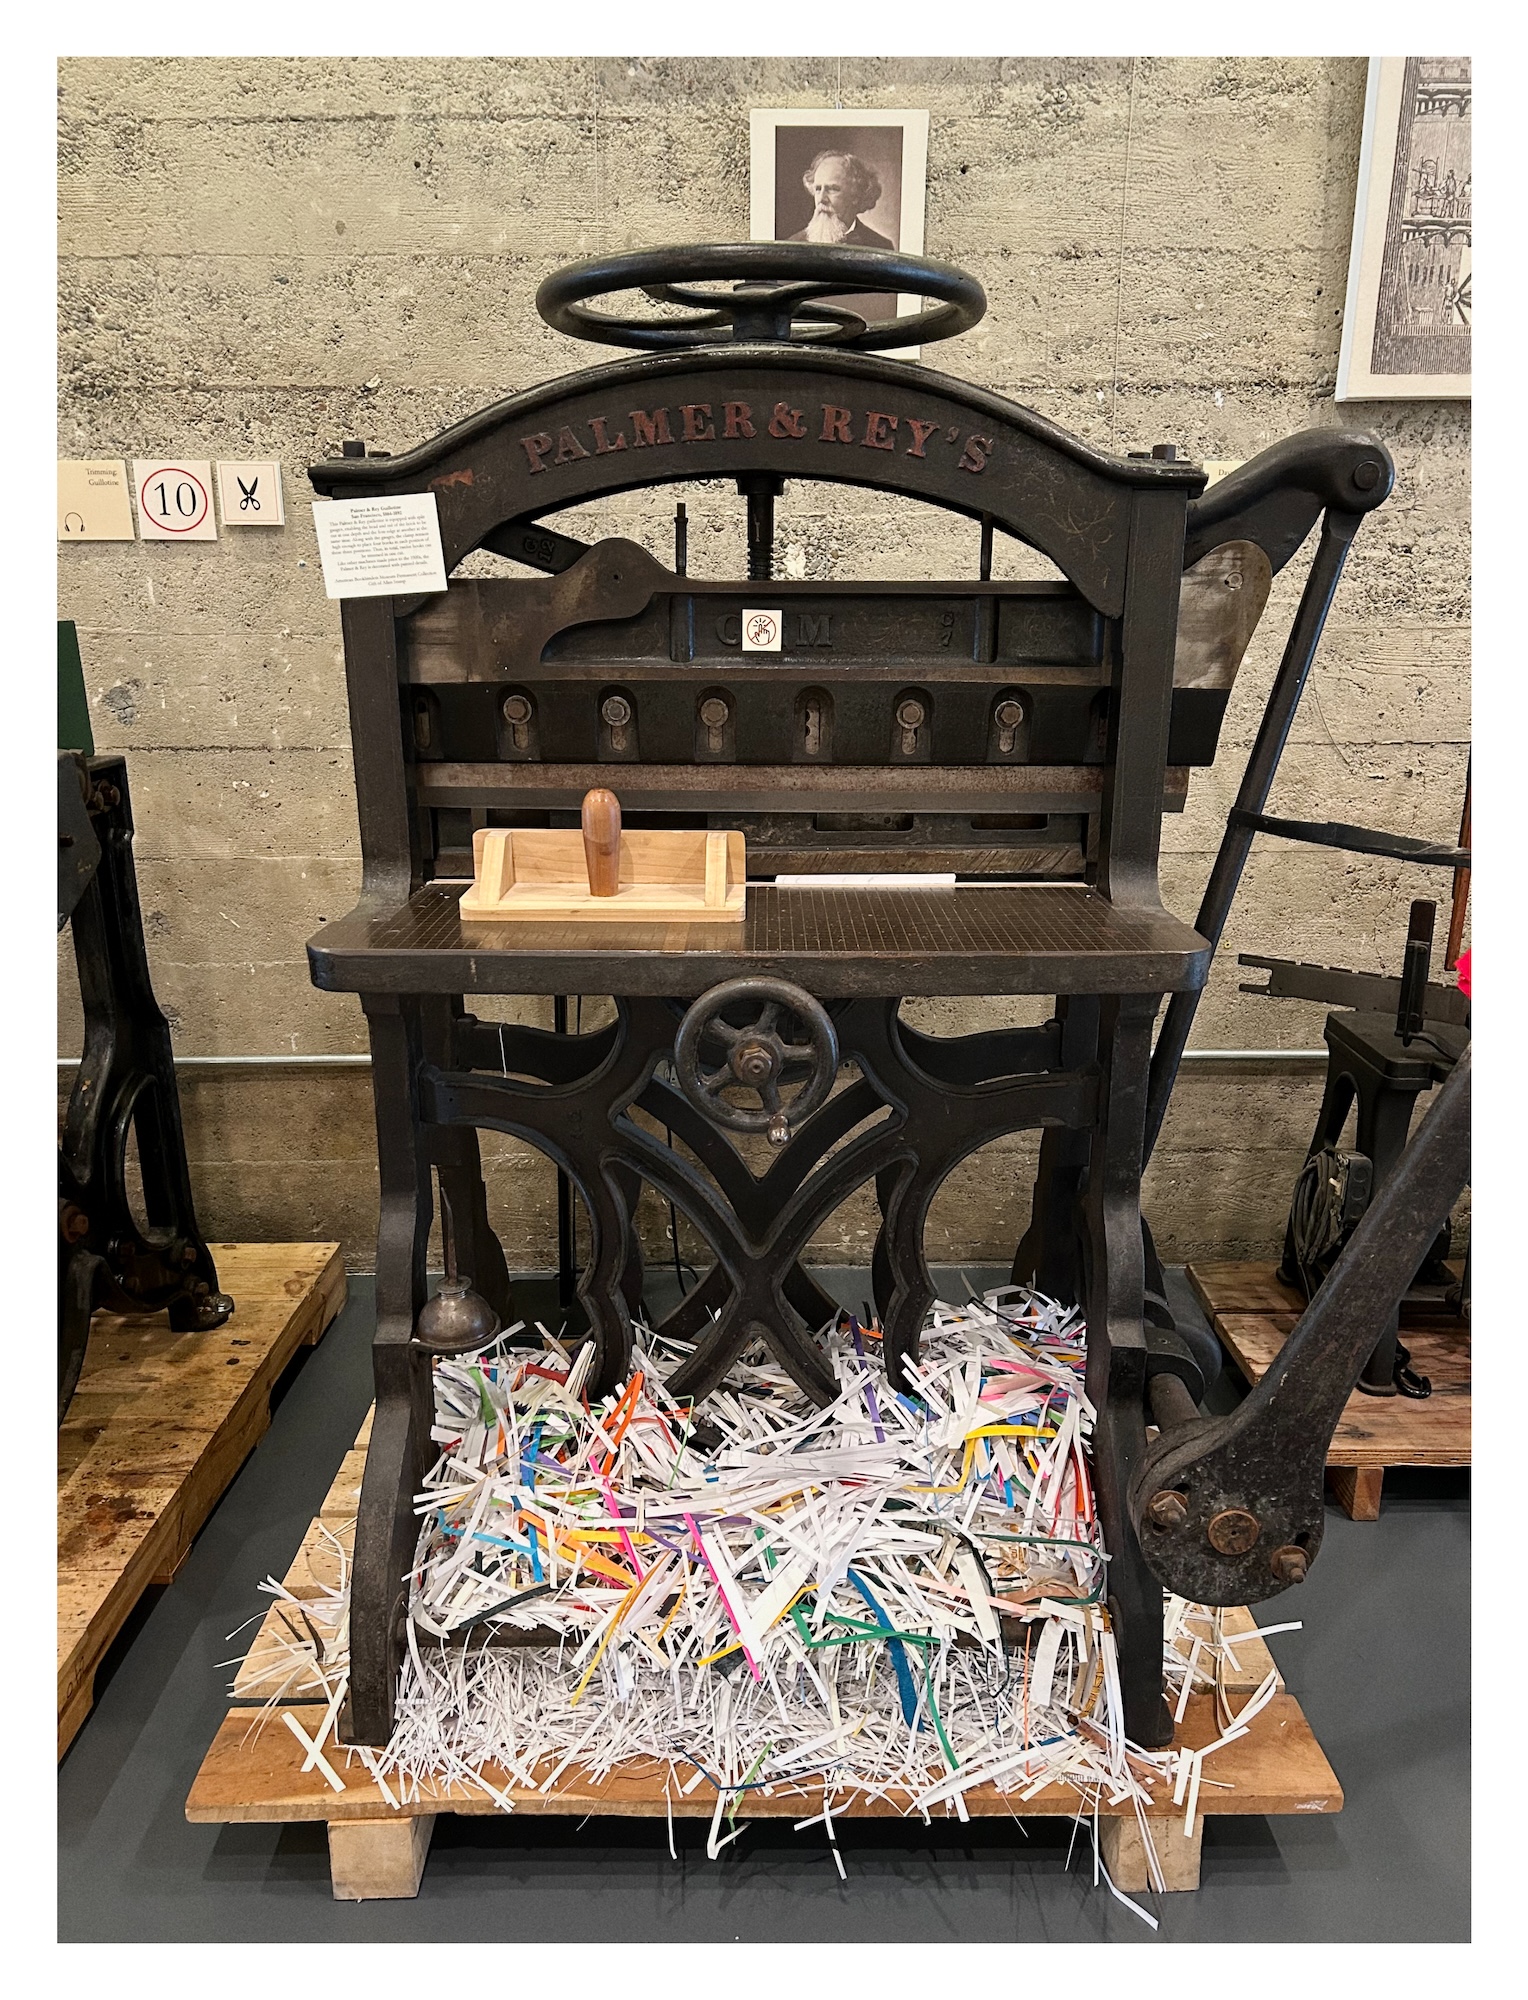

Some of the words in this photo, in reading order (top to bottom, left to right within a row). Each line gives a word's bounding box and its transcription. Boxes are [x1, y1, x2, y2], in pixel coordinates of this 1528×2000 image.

[520, 401, 757, 474] PALMER
[768, 401, 808, 438] &
[818, 403, 994, 473] REY'S
[154, 482, 197, 516] 10
